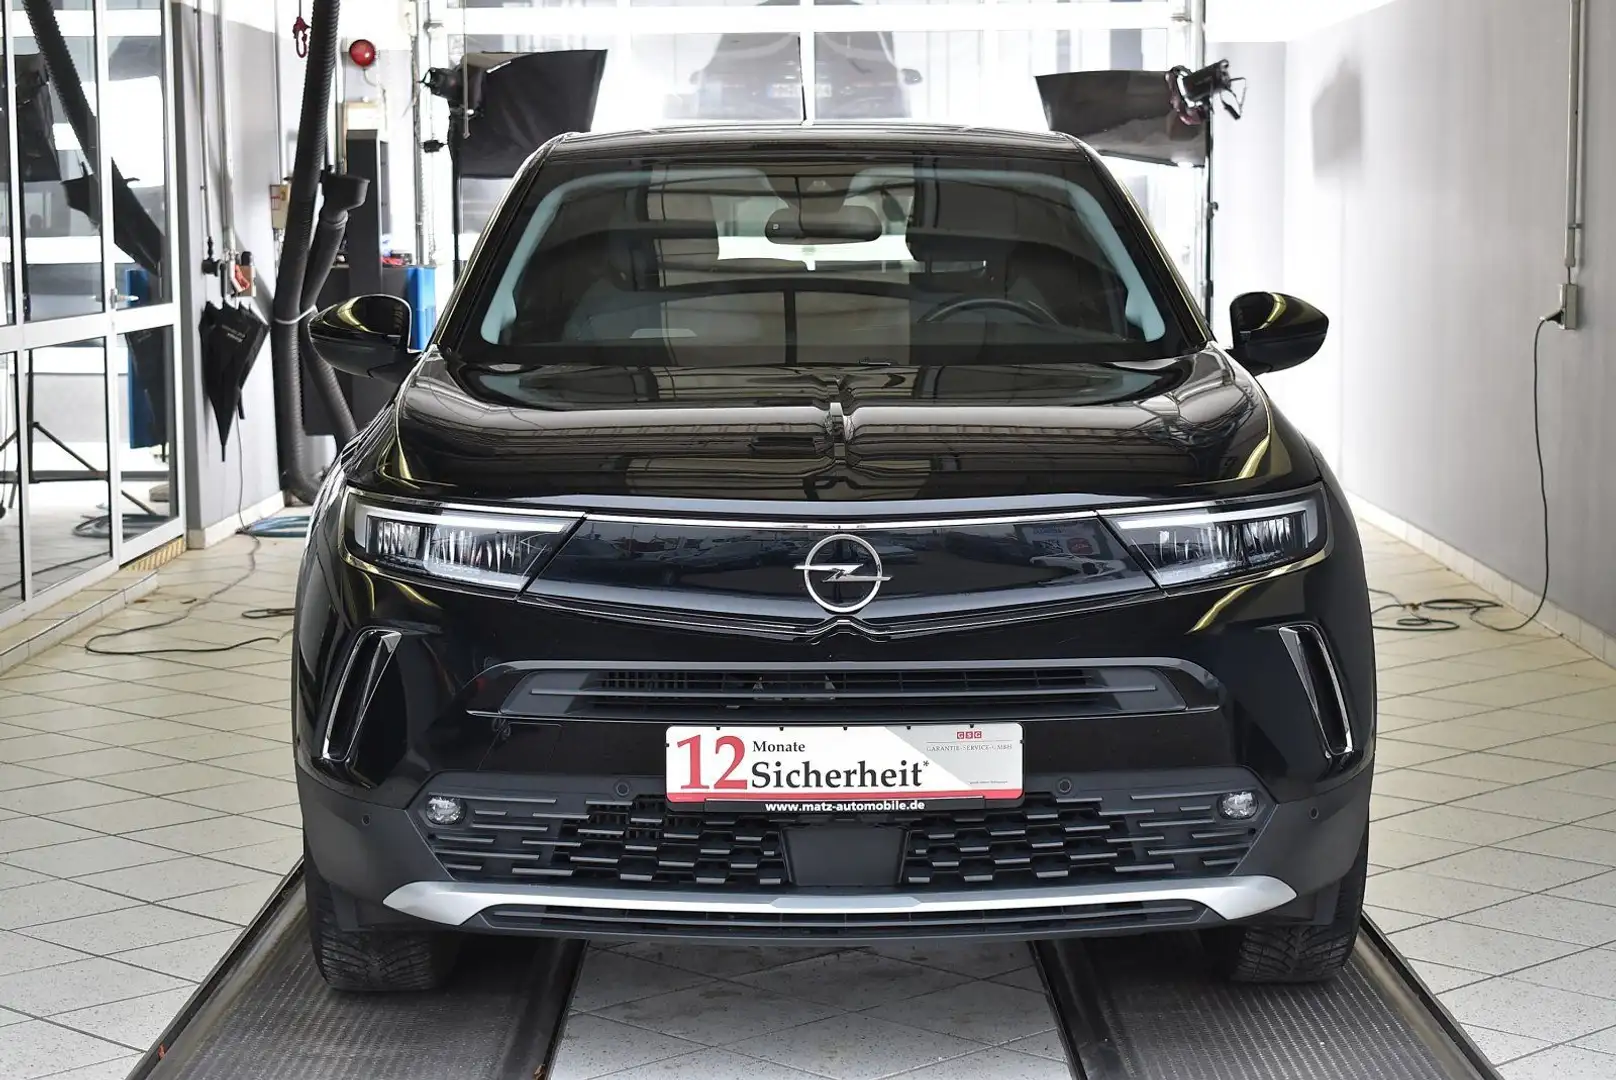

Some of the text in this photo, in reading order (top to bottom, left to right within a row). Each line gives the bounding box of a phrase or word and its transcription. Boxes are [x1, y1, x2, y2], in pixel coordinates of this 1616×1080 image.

[752, 741, 806, 753] Monate
[677, 734, 748, 790] 12
[765, 800, 926, 812] www.matz-automobile.de
